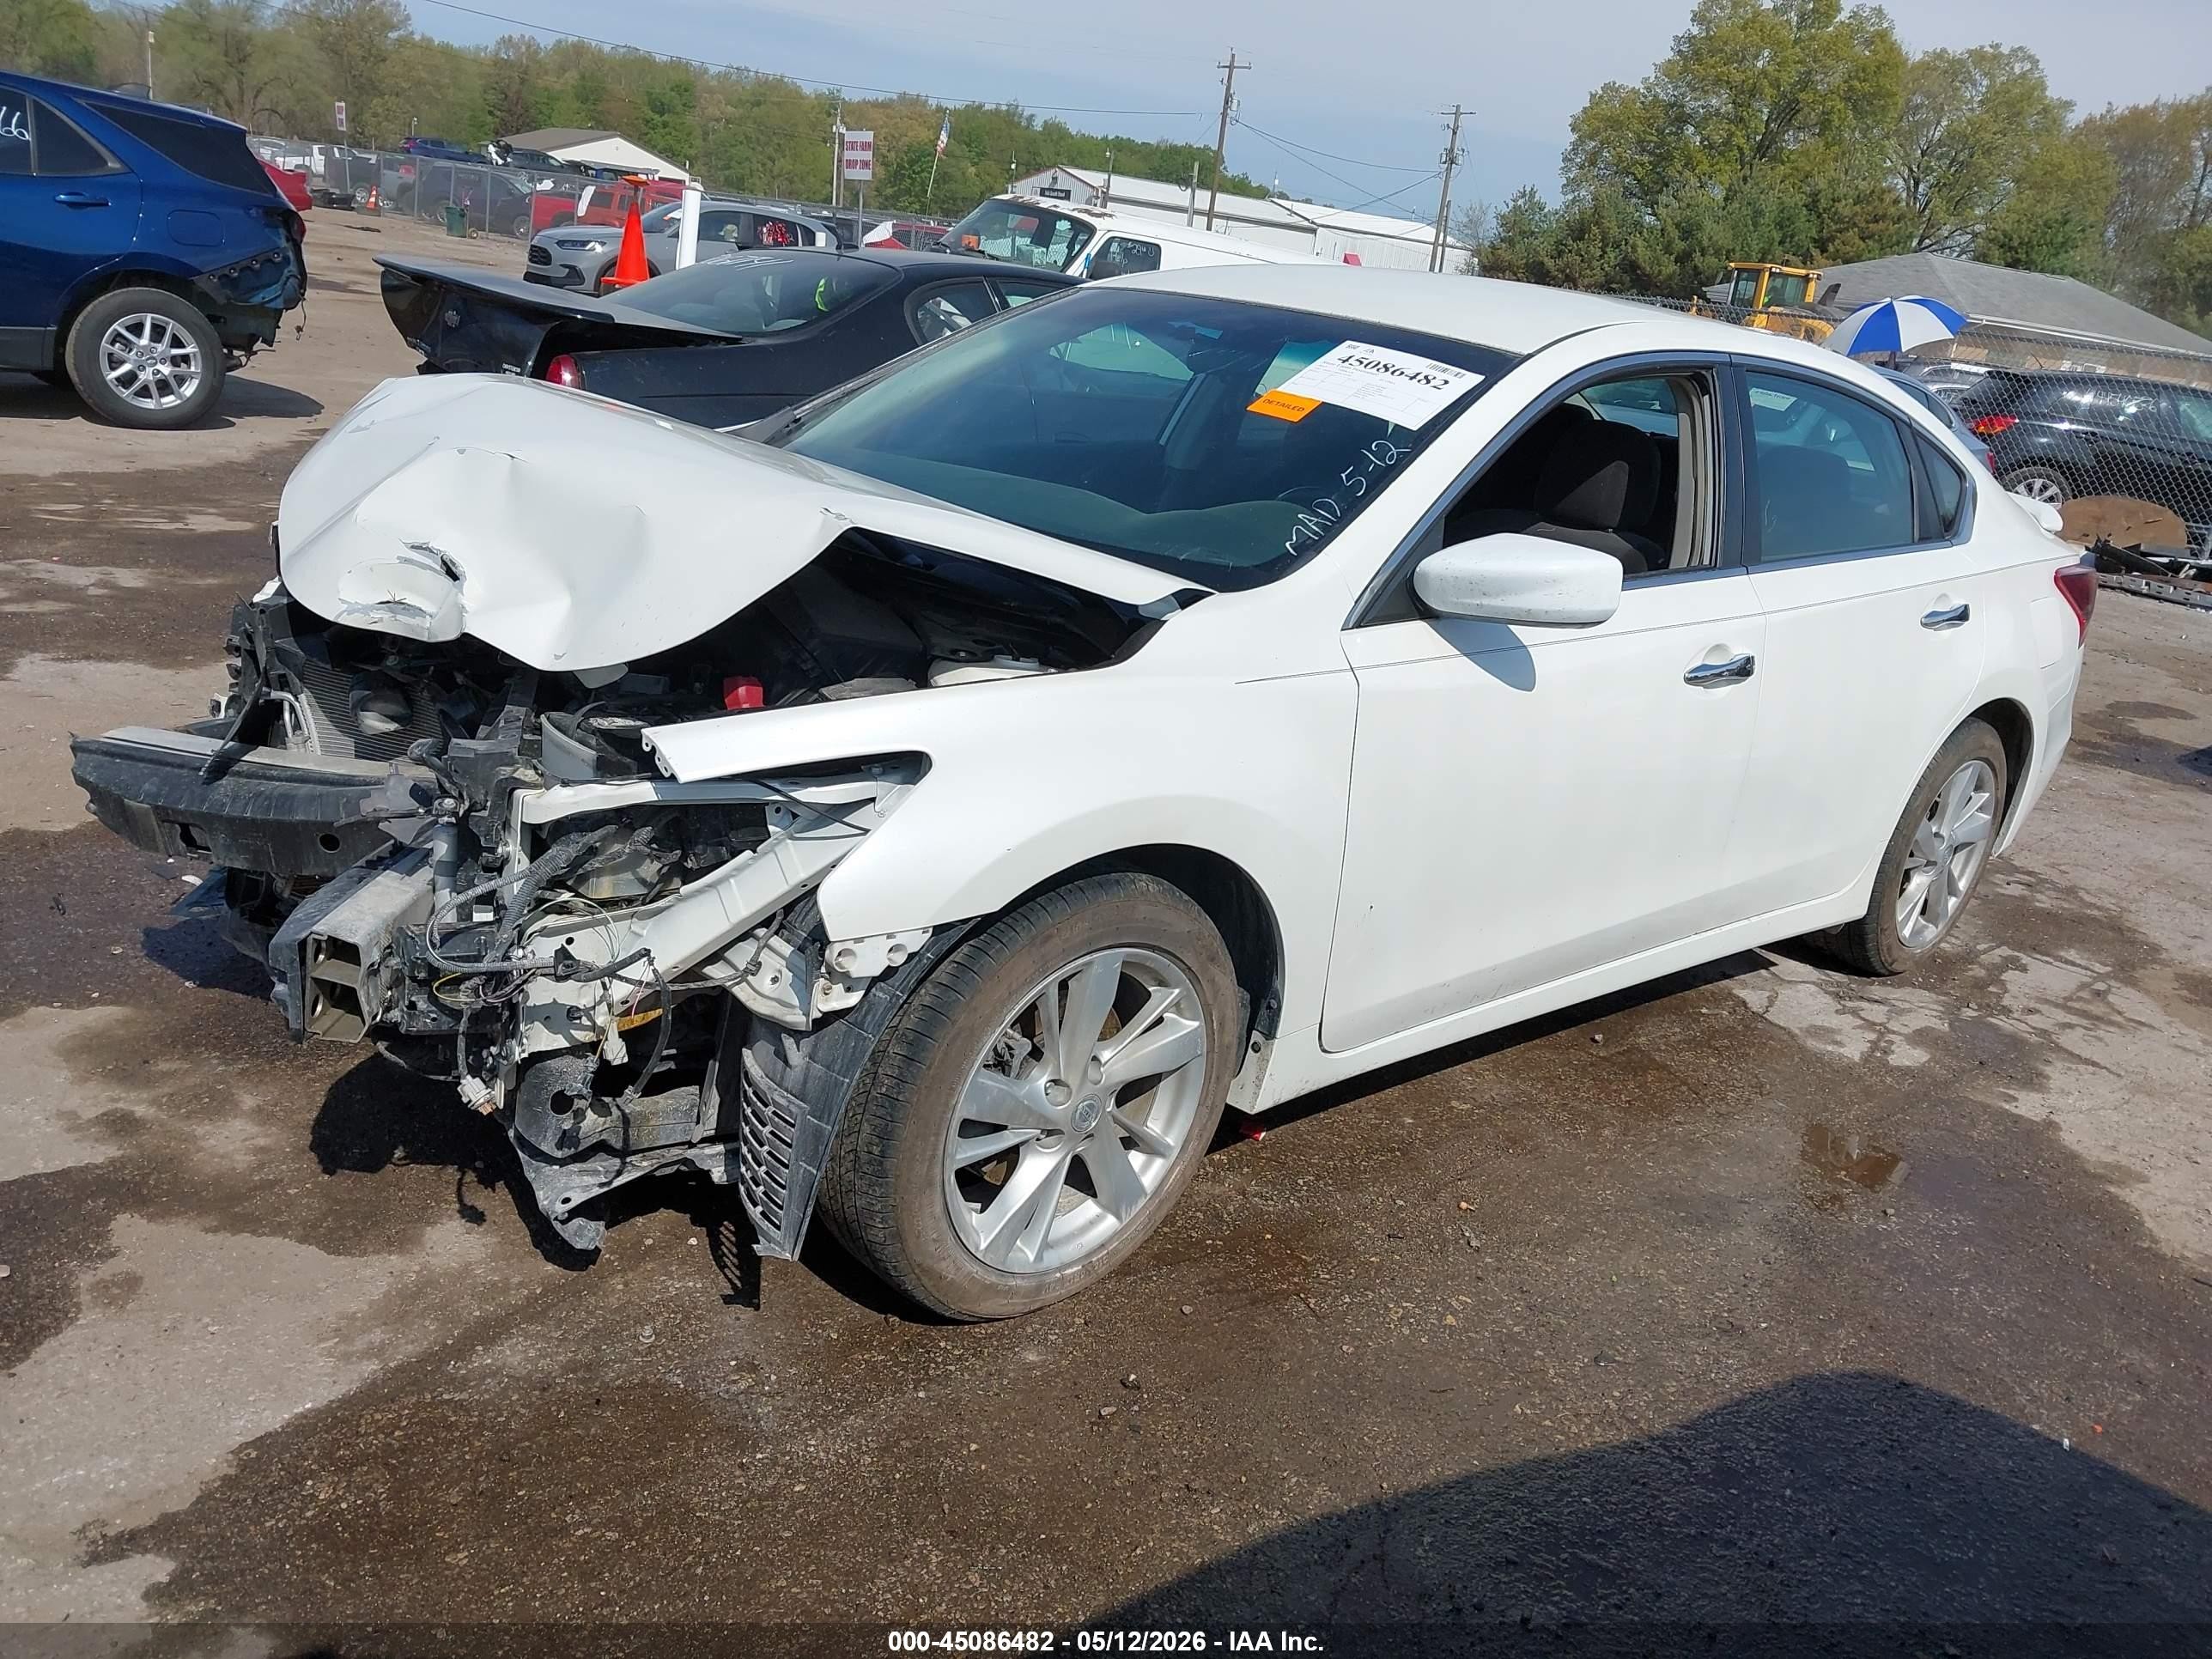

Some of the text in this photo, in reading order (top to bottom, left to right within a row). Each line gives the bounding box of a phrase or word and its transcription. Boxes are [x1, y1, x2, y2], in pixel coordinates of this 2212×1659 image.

[845, 140, 872, 152] STATE FARM
[845, 158, 872, 171] DROP ZONE
[1337, 354, 1450, 391] 45086482
[1262, 398, 1305, 412] DETAILED
[1285, 498, 1341, 556] MAD
